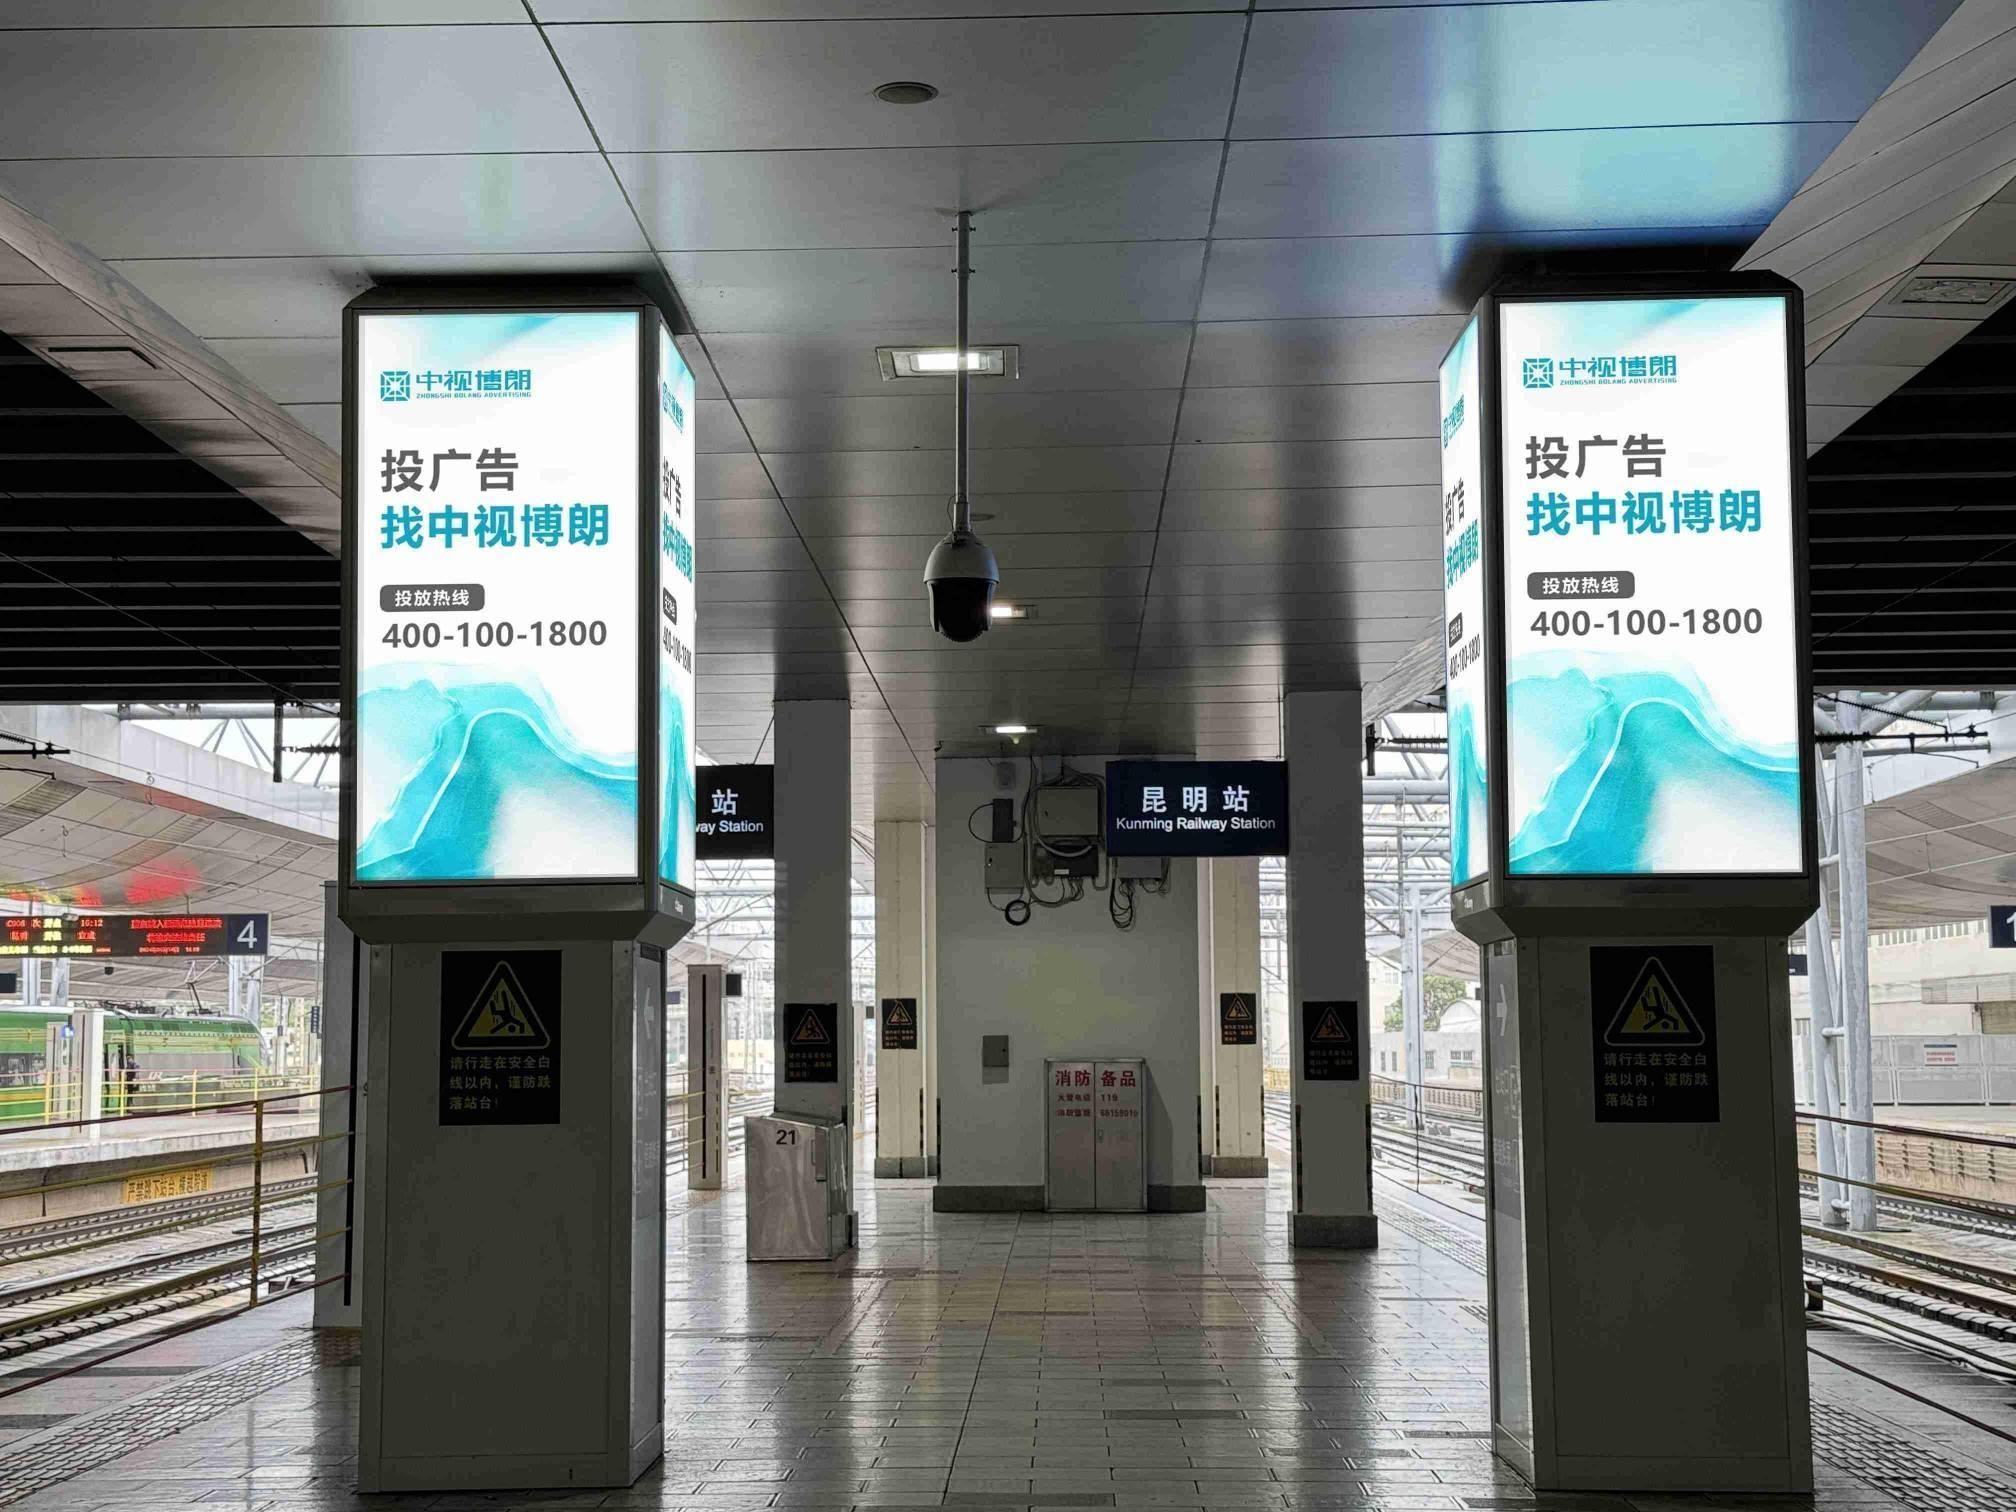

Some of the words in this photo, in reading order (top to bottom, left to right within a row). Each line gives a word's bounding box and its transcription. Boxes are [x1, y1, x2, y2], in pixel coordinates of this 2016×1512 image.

[1559, 355, 1677, 378] 中视博朗
[416, 369, 532, 391] 中视博朗
[1525, 434, 1666, 479] 投广告
[380, 448, 519, 493] 投广告
[1526, 489, 1762, 536] 找中视博朗
[380, 503, 609, 549] 找中视博朗
[1542, 576, 1620, 595] 投放热线
[394, 589, 470, 607] 投放热线
[1530, 607, 1763, 637] 400-100-1800
[381, 620, 607, 648] 400-100-1800
[711, 788, 739, 815] 站
[1142, 785, 1250, 813] 昆明站
[719, 820, 763, 833] Station
[1116, 817, 1173, 832] Kunming
[1176, 817, 1227, 832] Railway
[1230, 816, 1276, 830] Station
[236, 920, 258, 949] 4
[450, 1055, 551, 1070] 请行走在安全白
[1055, 1069, 1091, 1087] 消防
[1101, 1069, 1136, 1087] 备品
[1101, 1094, 1118, 1102] 119
[776, 1129, 796, 1145] 21
